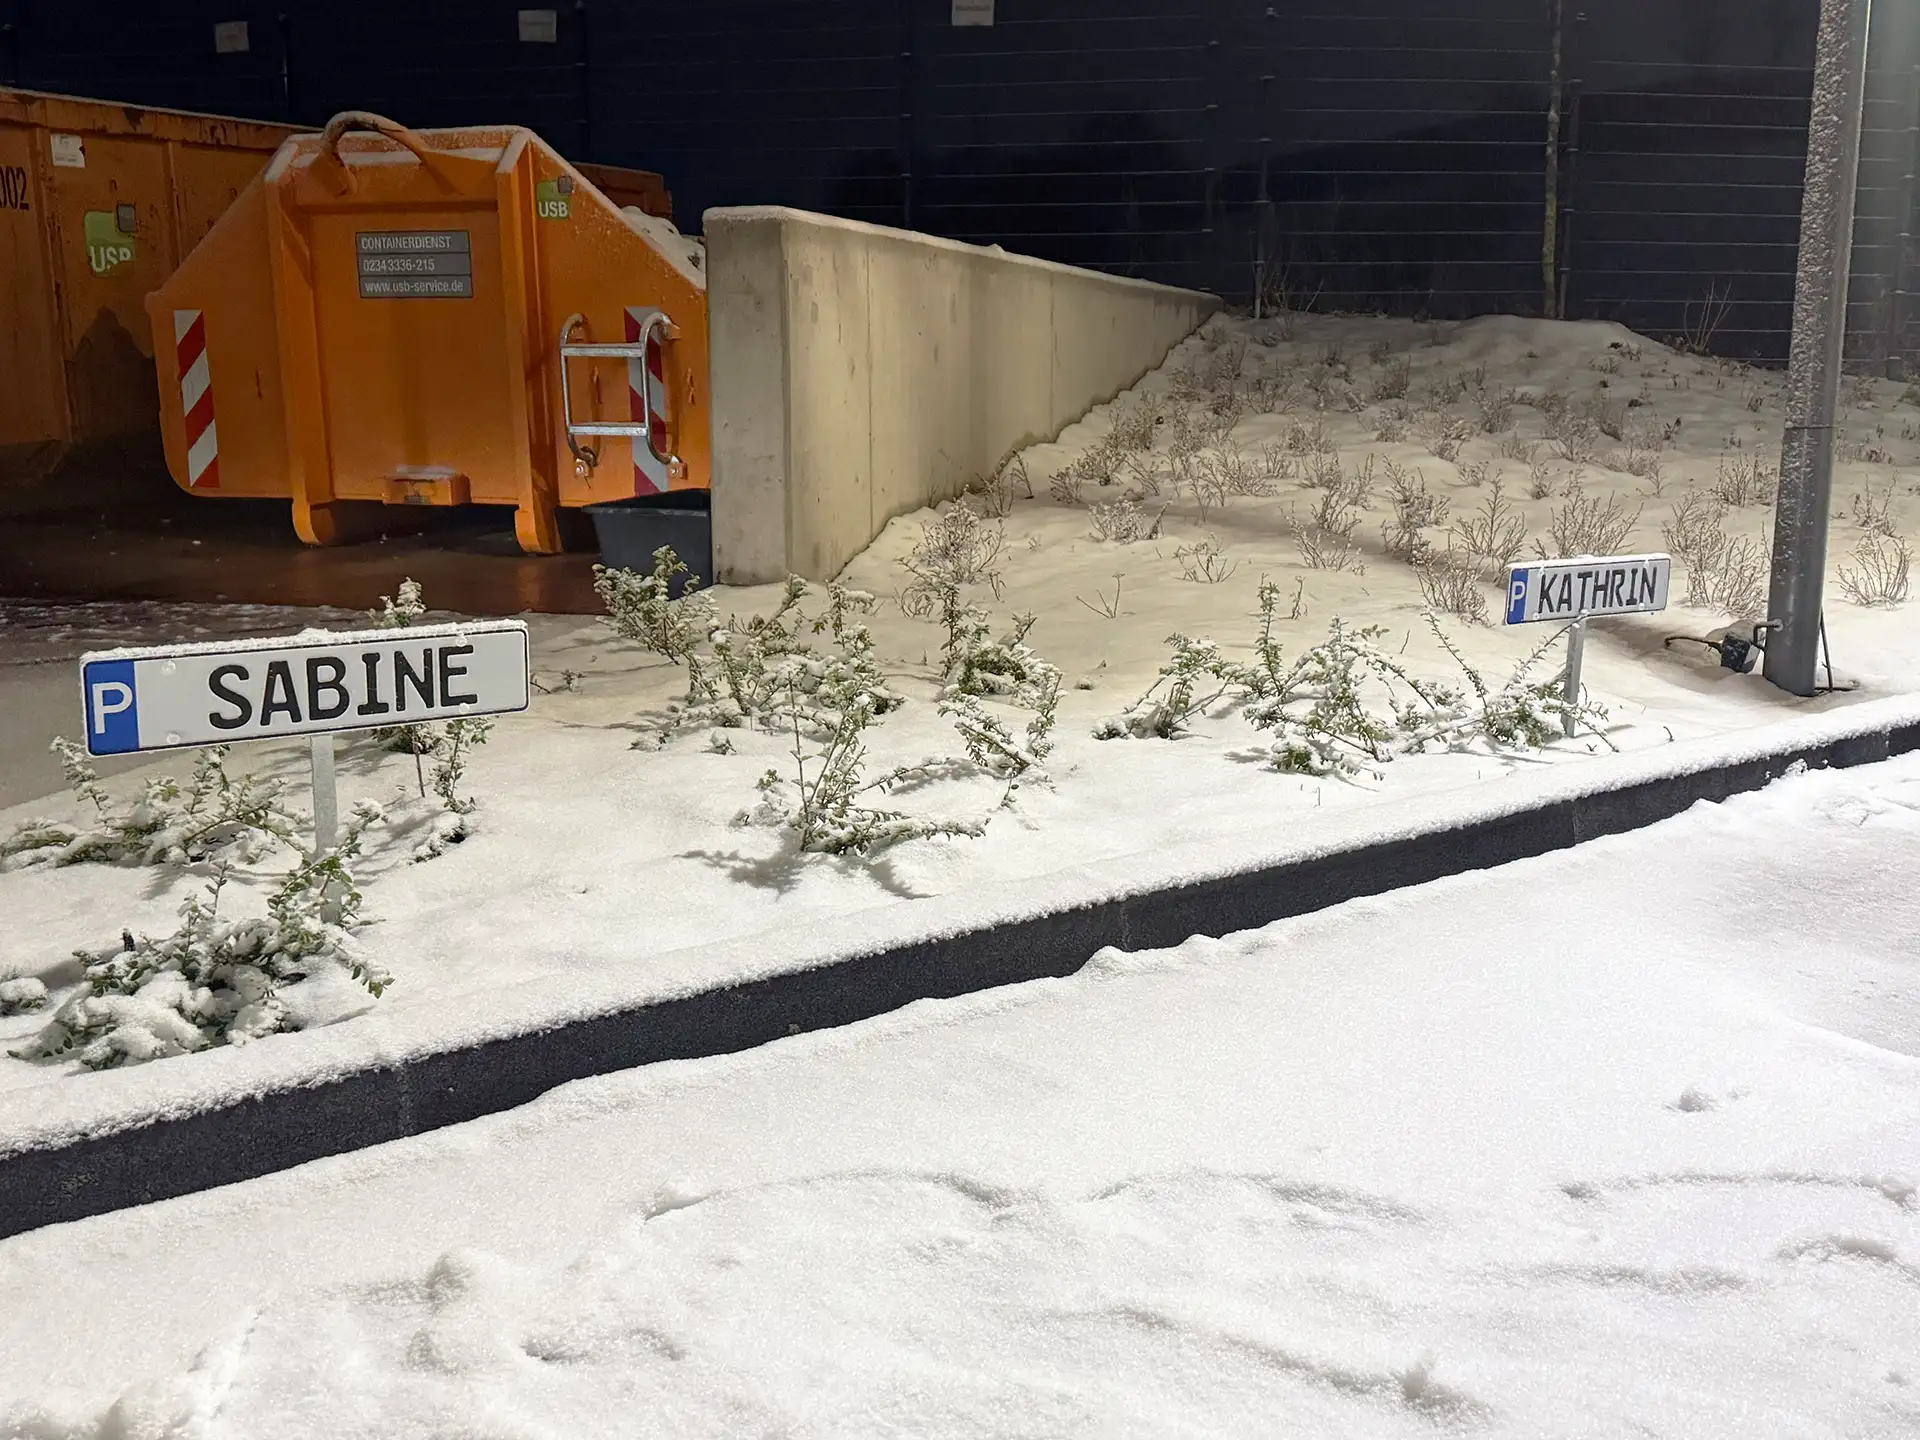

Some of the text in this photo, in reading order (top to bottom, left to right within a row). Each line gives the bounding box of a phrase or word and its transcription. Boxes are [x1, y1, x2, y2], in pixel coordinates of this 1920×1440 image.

[538, 200, 569, 218] USB
[361, 236, 452, 250] CONTAINERDIENST
[364, 279, 464, 292] www.usb-service.de
[1509, 566, 1658, 615] P KATHRIN
[92, 645, 478, 734] P SABINE
